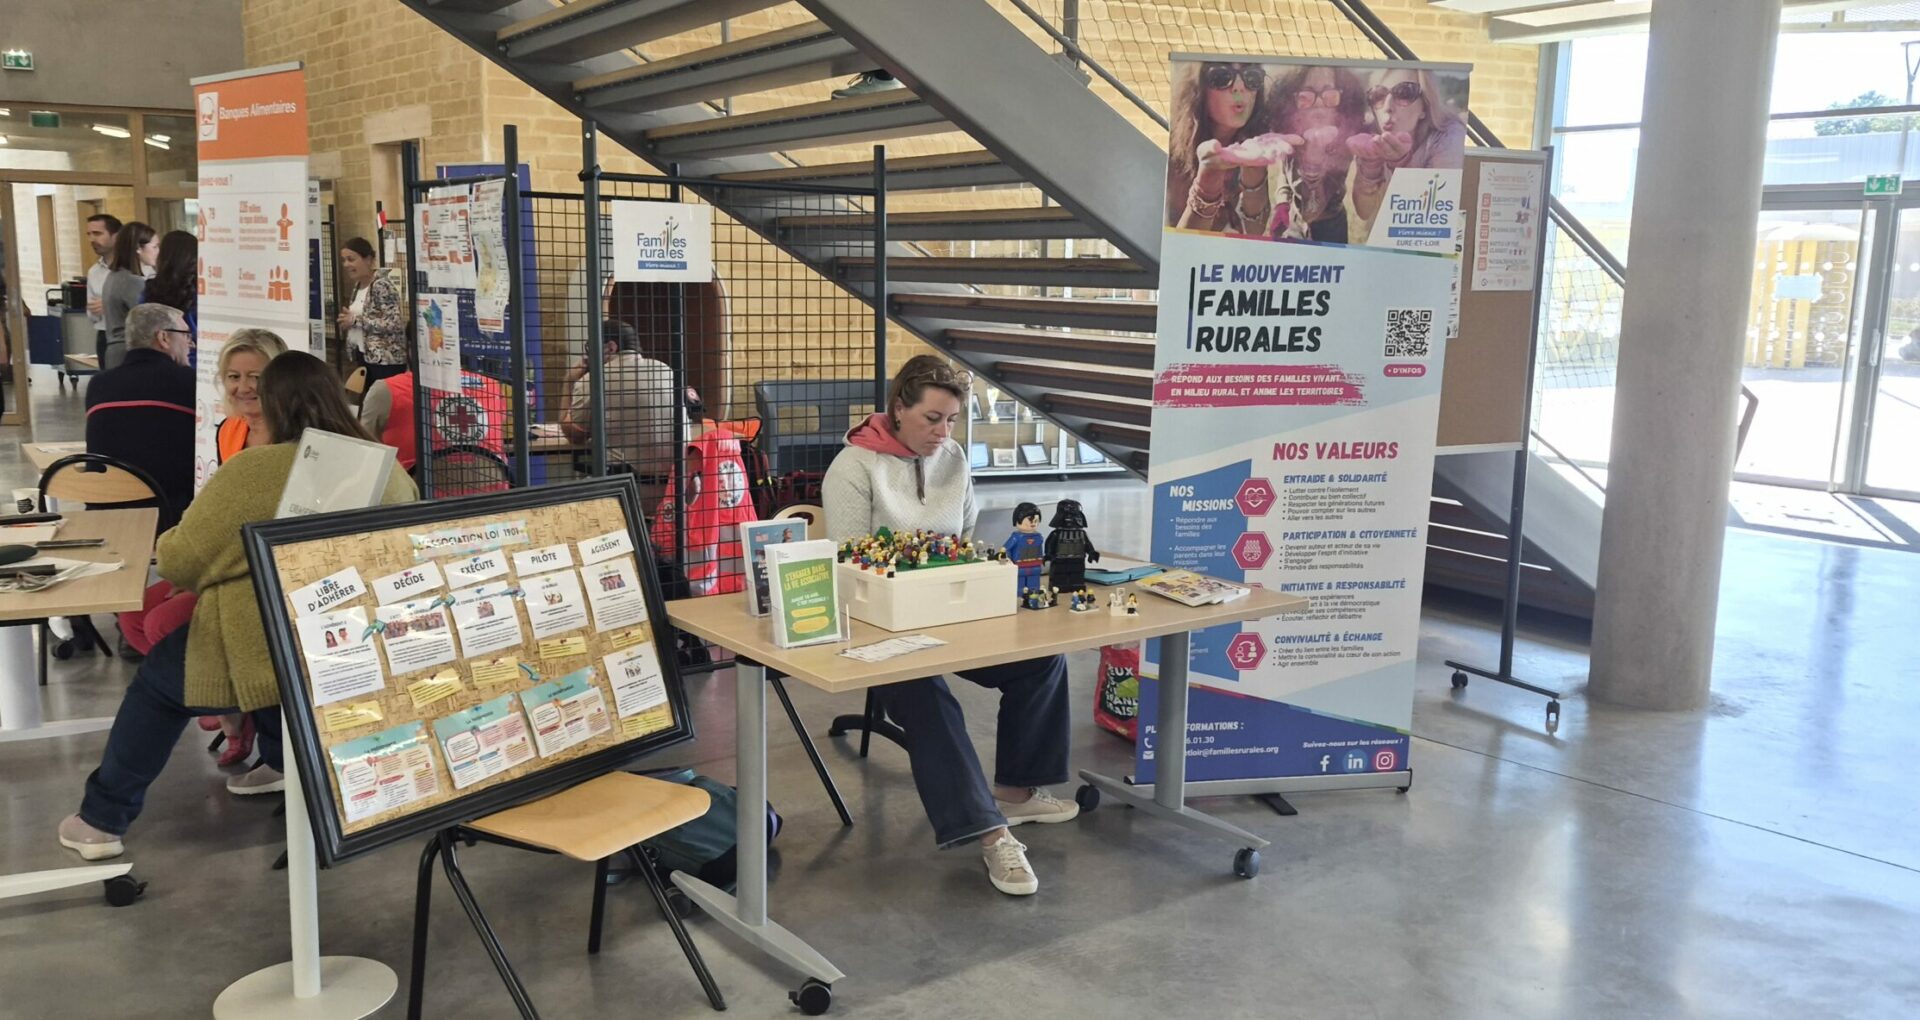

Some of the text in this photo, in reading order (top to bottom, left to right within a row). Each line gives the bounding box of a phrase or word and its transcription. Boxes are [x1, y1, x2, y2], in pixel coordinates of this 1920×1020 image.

[220, 100, 296, 120] Banques Alimentaires
[1390, 178, 1453, 211] Familles
[1392, 212, 1448, 225] rurales
[637, 221, 686, 248] Familles
[640, 248, 684, 258] rurales
[1200, 264, 1345, 283] LE MOUVEMENT
[1197, 289, 1331, 317] FAMILLES
[1195, 326, 1322, 352] RURALES
[1171, 373, 1203, 383] RÉPOND
[1225, 375, 1255, 383] BESOINS
[1257, 375, 1272, 383] DES
[1274, 374, 1310, 383] FAMILLES
[1312, 374, 1340, 383] VIVANT
[1171, 388, 1181, 396] EN
[1184, 388, 1209, 396] MILIEU
[1240, 388, 1250, 396] ET
[1253, 388, 1277, 396] ANIME
[1279, 388, 1294, 396] LES
[1297, 387, 1343, 396] TERRITOIRES
[1273, 442, 1399, 460] NOS VALEURS
[1284, 472, 1387, 483] ENTRAIDE & SOLIDARITÉ
[1170, 486, 1194, 498] NOS
[1182, 499, 1234, 512] MISSIONS
[485, 531, 499, 540] LOI
[1283, 527, 1417, 539] PARTICIPATION & CITOYENNETÉ
[591, 540, 620, 554] AGISSENT
[531, 552, 557, 563] PILOTE
[460, 559, 495, 574] EXÉCUTE
[394, 573, 425, 590] DÉCIDE
[1281, 583, 1323, 592] INITIATIVE
[1336, 579, 1406, 590] RESPONSABILITÉ
[315, 581, 340, 597] LIBRE
[308, 585, 356, 612] D'ADHÉRER
[1275, 631, 1383, 644] CONVIVIALITÉ & ÉCHANGE
